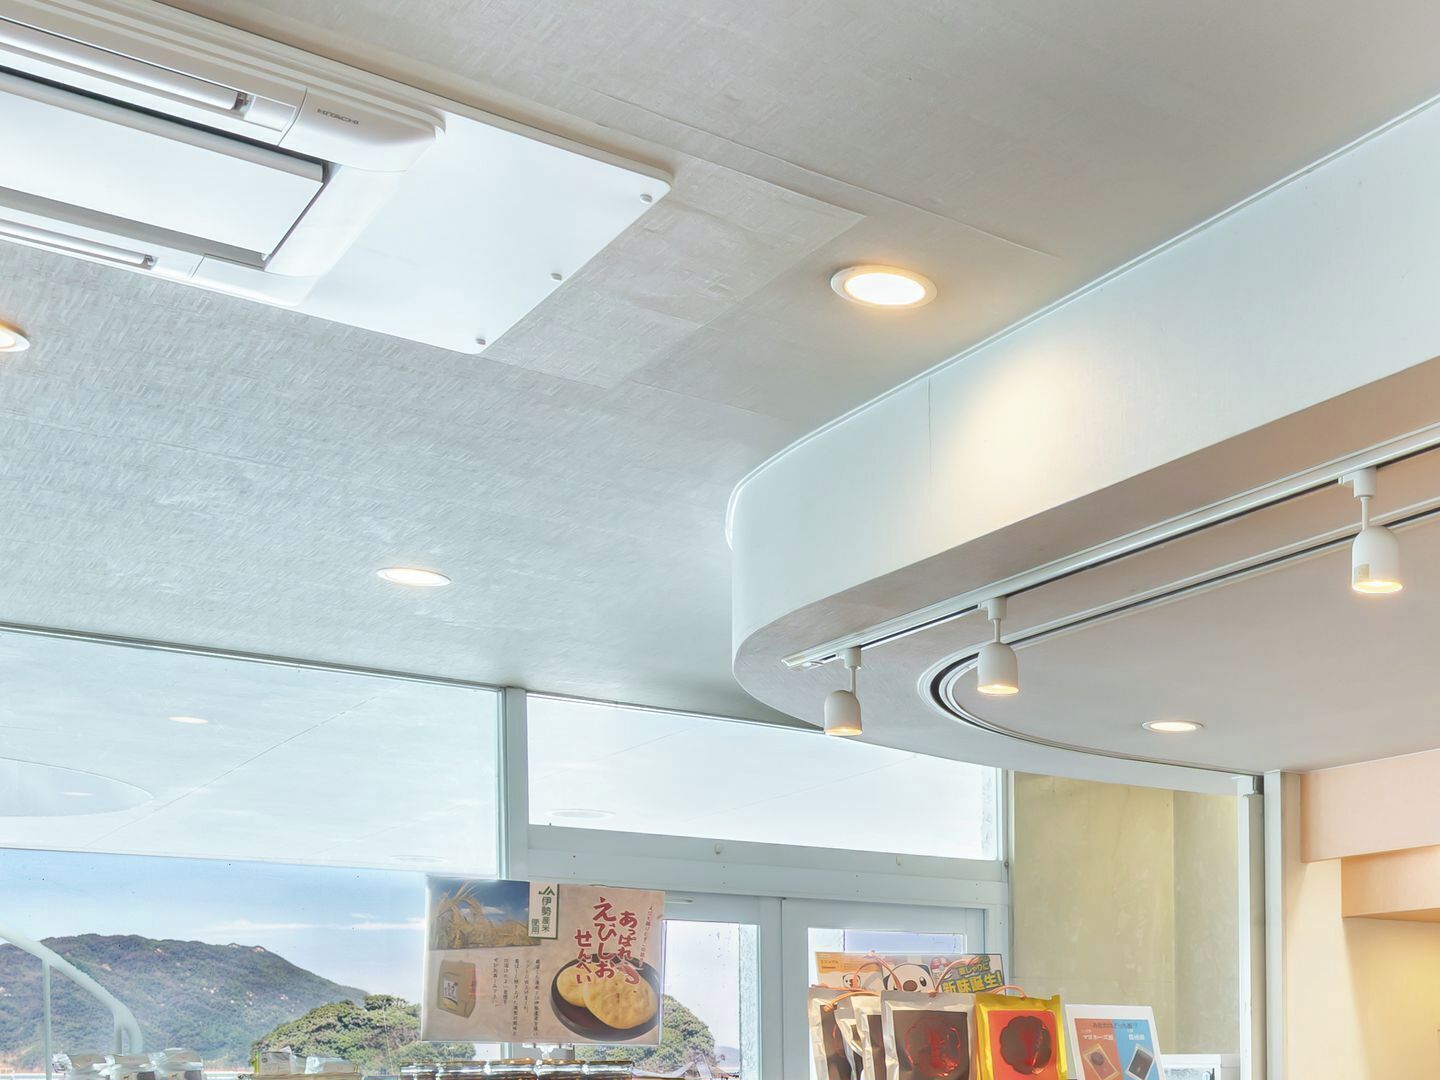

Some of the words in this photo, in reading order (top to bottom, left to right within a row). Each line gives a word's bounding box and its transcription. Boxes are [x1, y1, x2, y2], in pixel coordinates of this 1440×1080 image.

[317, 109, 359, 125] HITACHI
[531, 917, 540, 934] 使用
[541, 896, 553, 933] 伊勢産米
[592, 896, 617, 979] えびしお
[617, 910, 638, 960] あっぱれ
